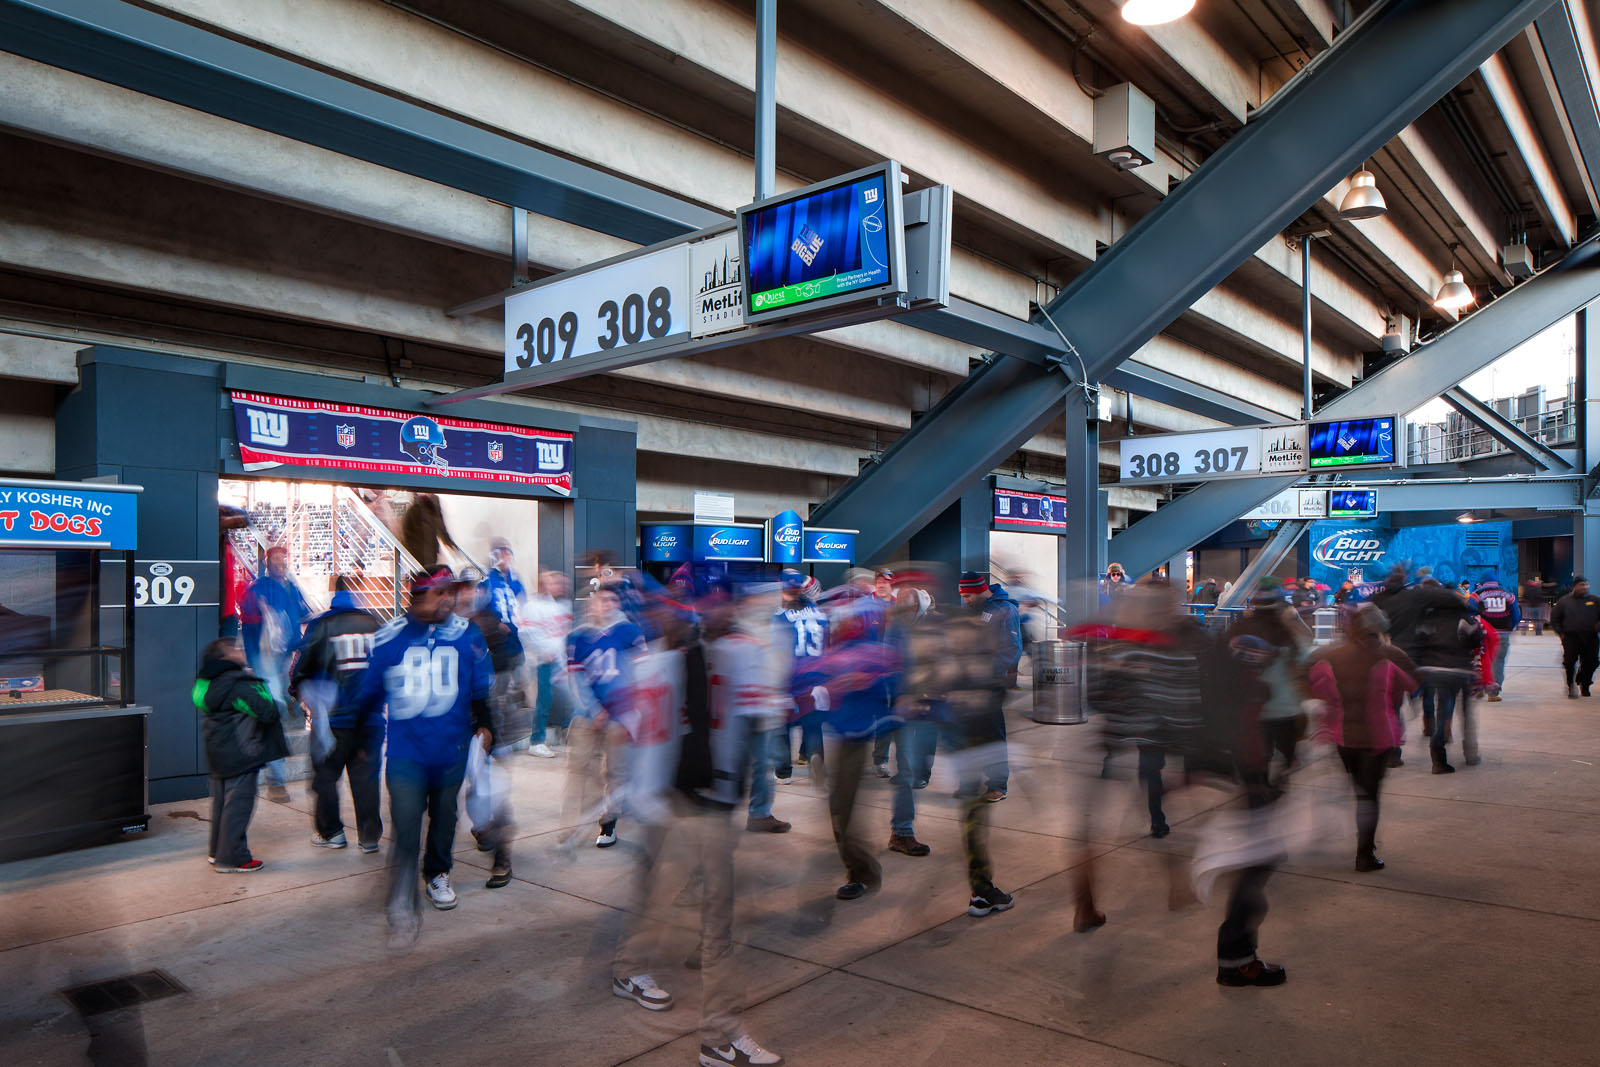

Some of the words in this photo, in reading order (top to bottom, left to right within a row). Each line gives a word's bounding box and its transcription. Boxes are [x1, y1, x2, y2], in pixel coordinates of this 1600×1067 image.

[702, 290, 742, 313] MetLif
[763, 291, 785, 303] Quest
[703, 308, 742, 323] STADIU
[516, 311, 578, 369] 309
[597, 286, 672, 350] 308
[339, 434, 353, 445] NFL
[489, 450, 502, 460] NFL
[1268, 453, 1303, 462] MetLife
[1130, 452, 1180, 478] 308
[1194, 446, 1248, 473] 307
[0, 491, 12, 503] Y
[17, 491, 83, 509] KOSHER
[87, 500, 113, 516] INC
[1260, 500, 1291, 515] 306
[30, 509, 103, 537] DOGS
[780, 534, 802, 542] LIGHT
[784, 527, 800, 536] BUD
[712, 537, 728, 545] BUD
[728, 538, 750, 546] LIGHT
[830, 542, 848, 550] LIGHT
[1334, 537, 1380, 550] BUD
[1324, 549, 1386, 561] LIGHT
[134, 575, 195, 605] 309
[393, 646, 459, 708] 80
